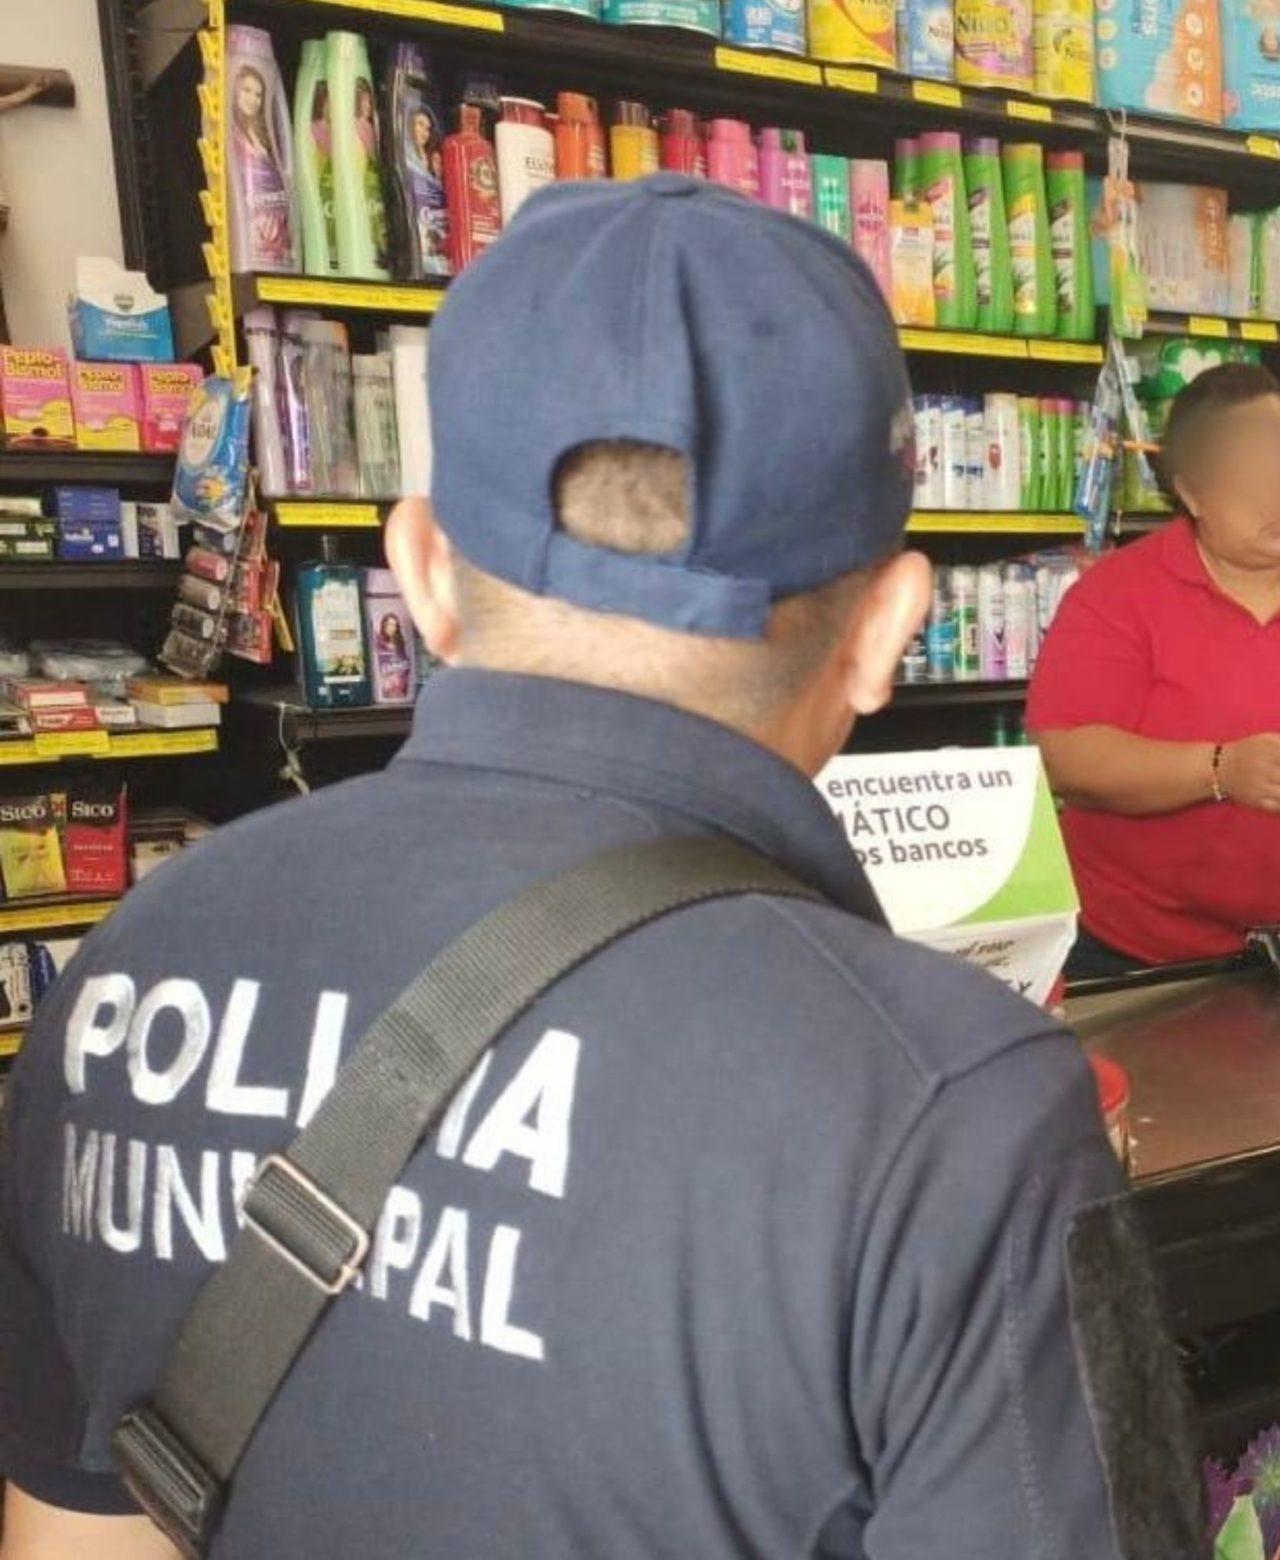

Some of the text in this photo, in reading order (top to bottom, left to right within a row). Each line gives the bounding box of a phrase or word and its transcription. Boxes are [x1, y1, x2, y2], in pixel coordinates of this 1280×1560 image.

[827, 769, 1013, 798] encuentra un
[838, 801, 950, 837] ÁTICO
[853, 838, 989, 866] os bancos
[63, 972, 581, 1199] POLIA
[62, 1121, 545, 1360] MUNPAL
